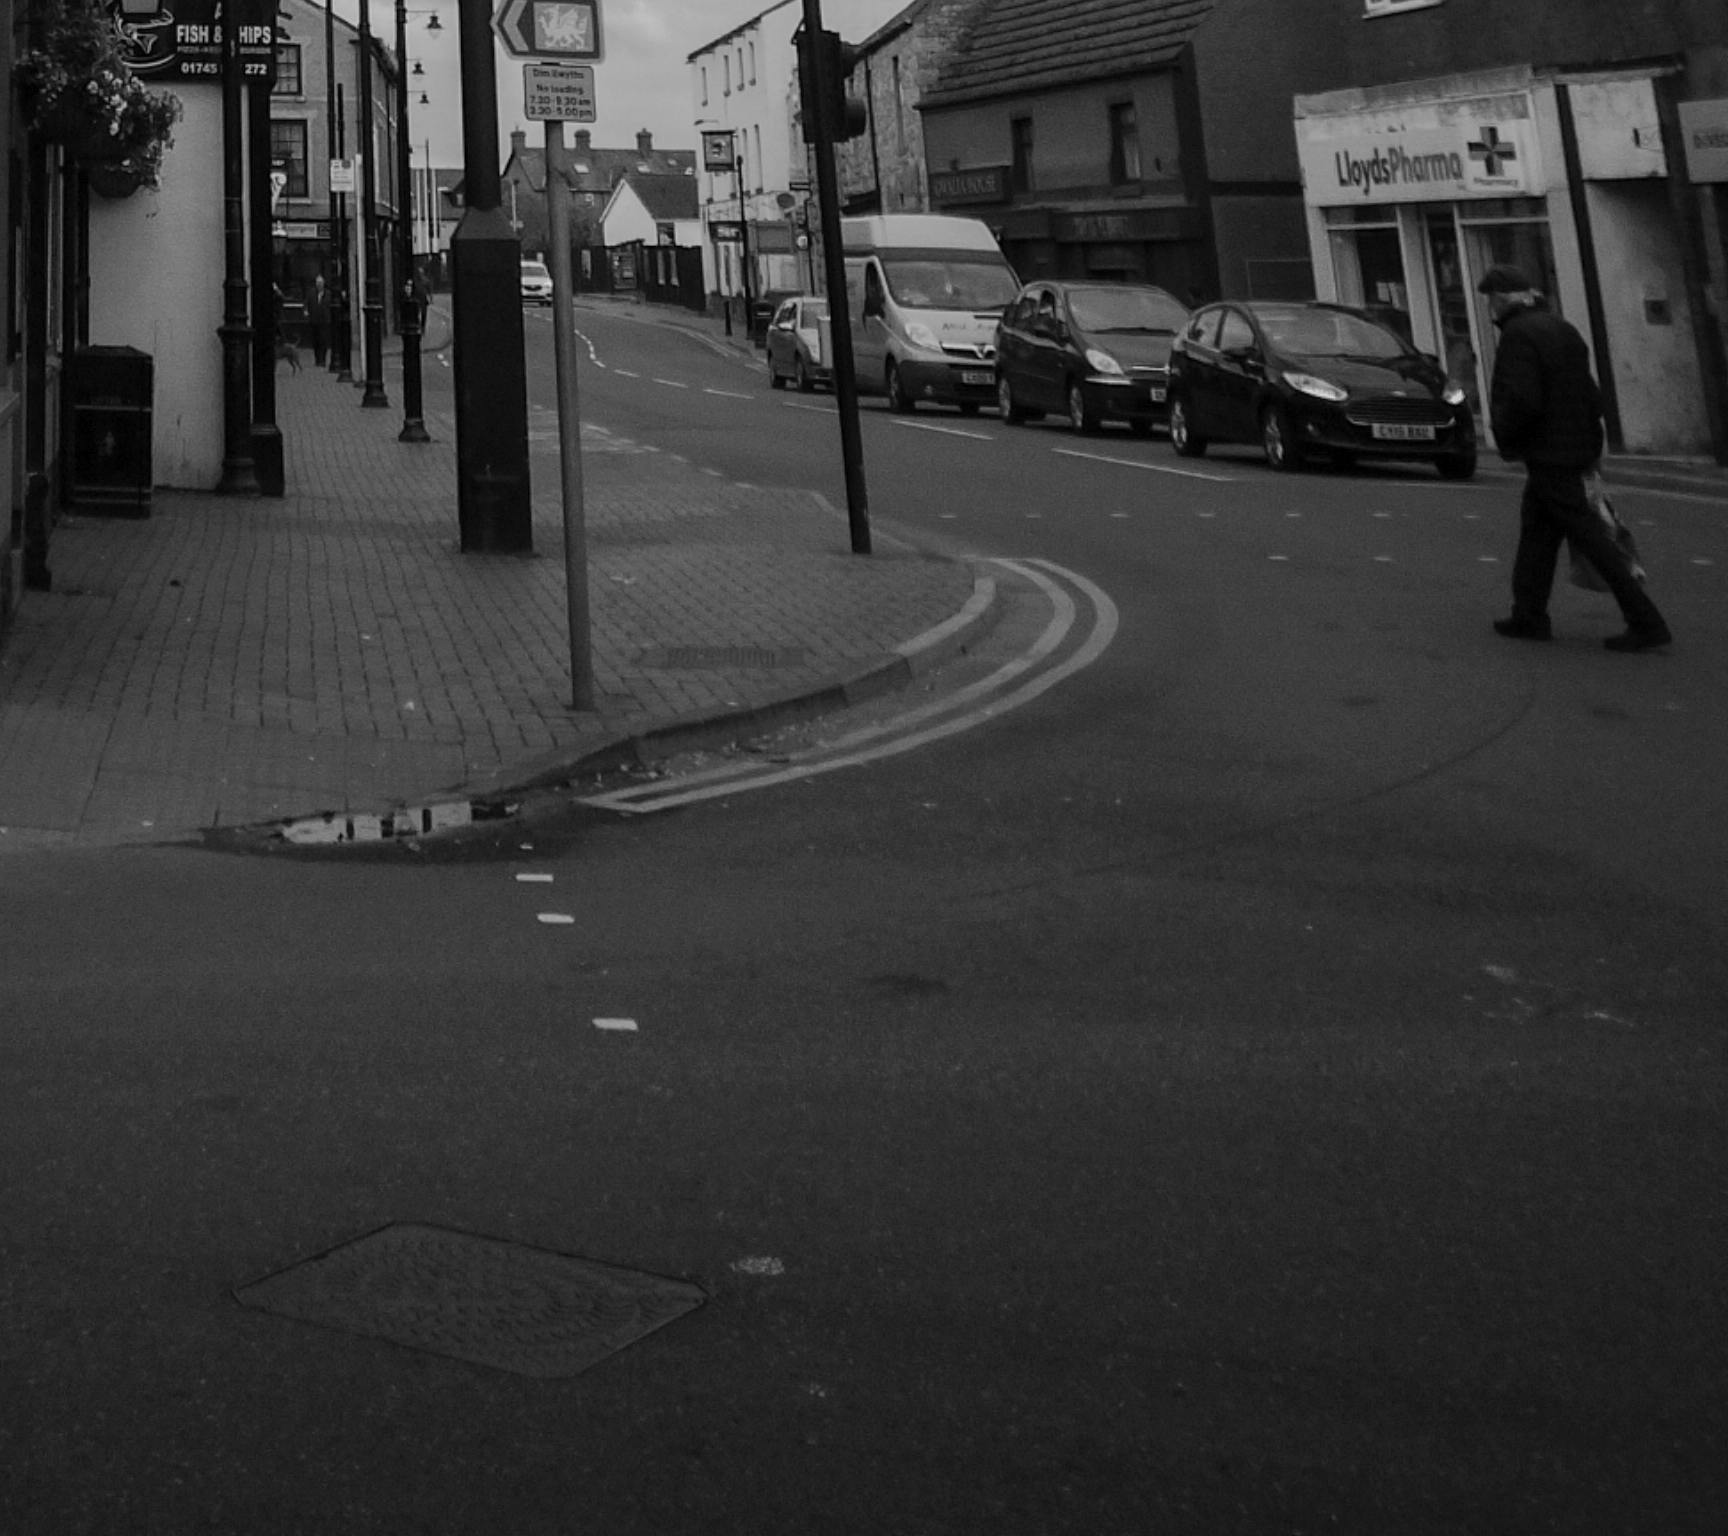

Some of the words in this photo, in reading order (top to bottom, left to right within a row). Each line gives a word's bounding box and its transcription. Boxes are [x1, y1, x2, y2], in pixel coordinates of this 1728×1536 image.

[176, 24, 210, 44] FISH
[238, 25, 272, 45] HIPS
[180, 62, 218, 75] 01745
[244, 62, 268, 76] 272
